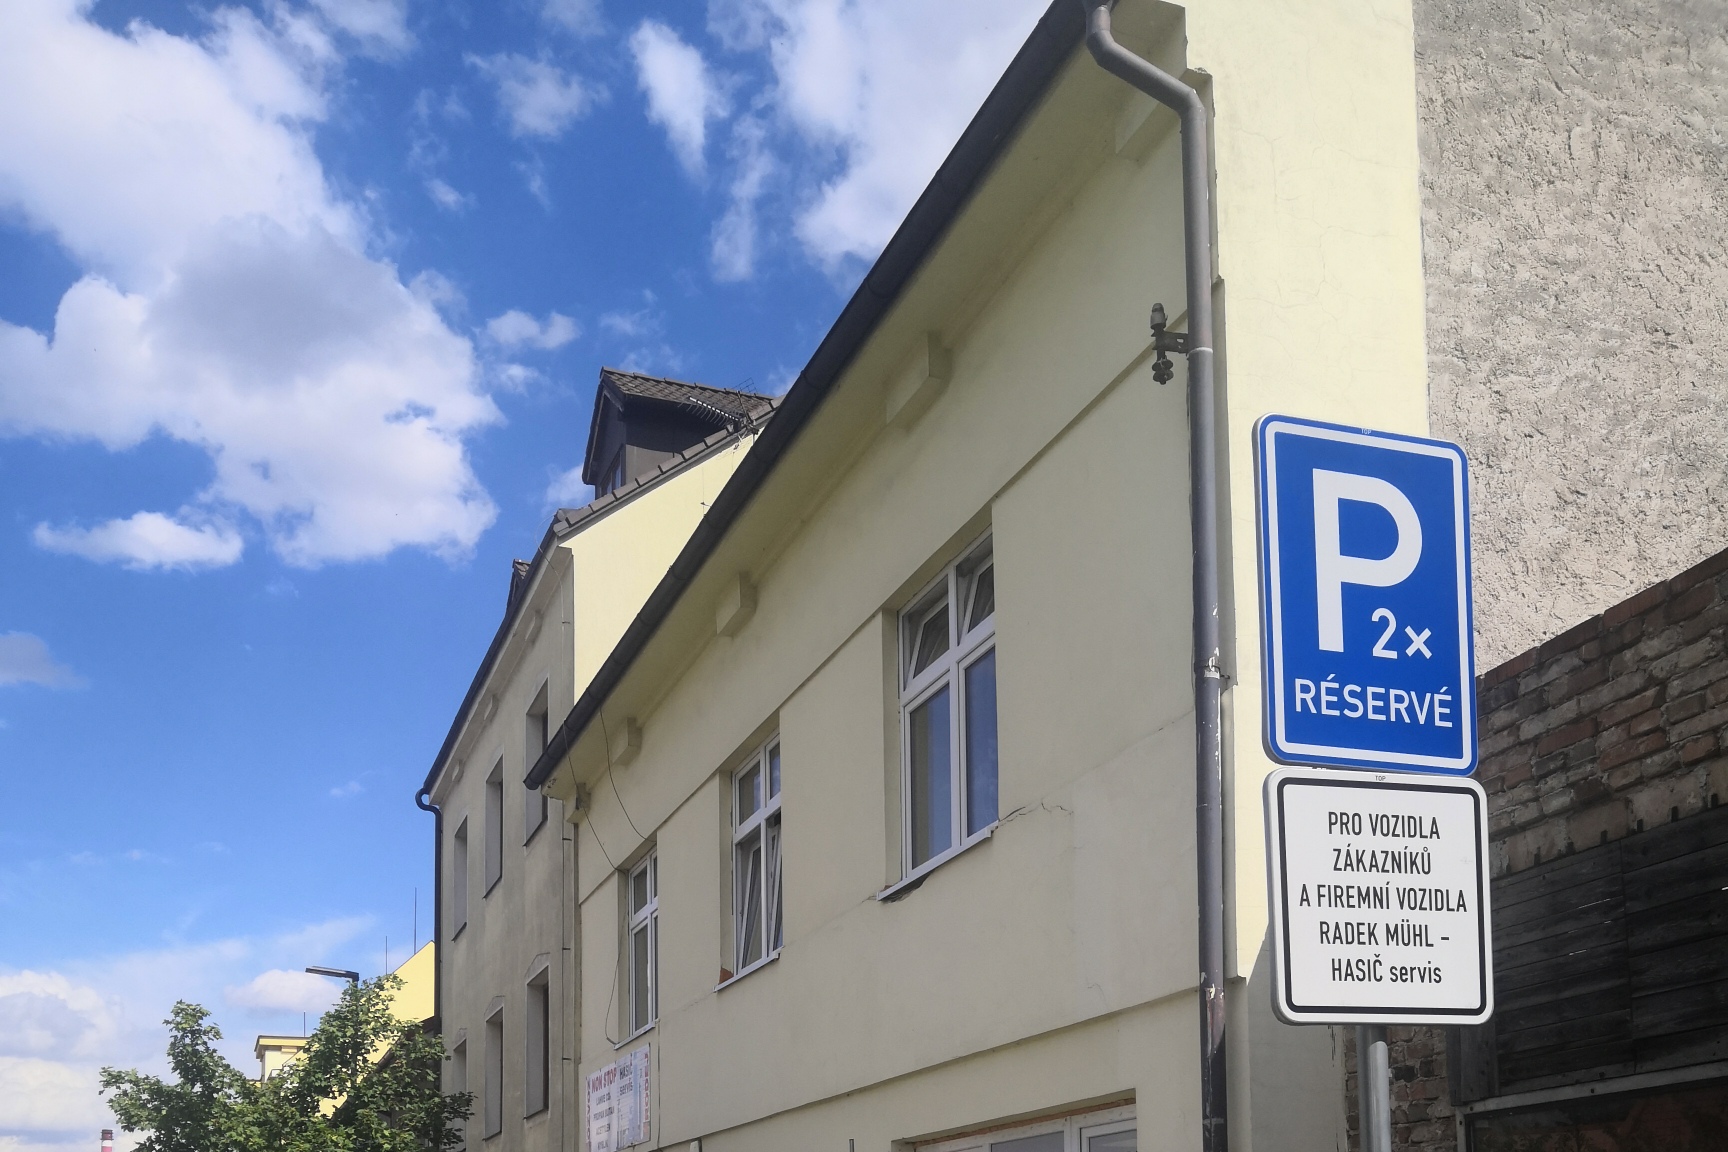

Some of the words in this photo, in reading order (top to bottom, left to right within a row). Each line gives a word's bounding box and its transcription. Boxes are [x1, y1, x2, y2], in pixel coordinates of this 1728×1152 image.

[1312, 468, 1423, 653] P
[1294, 673, 1453, 728] RÉSERVÉ
[1328, 811, 1362, 836] PRO
[1369, 813, 1441, 840] VOZIDLA
[1332, 843, 1432, 875] ZÁKAZNÍKŮ
[1299, 883, 1311, 907] A
[1316, 881, 1390, 910] FIREMNÍ
[1396, 887, 1468, 913] VOZIDLA
[1319, 920, 1379, 946] RADEK
[1385, 919, 1434, 948] MÜHL
[1331, 953, 1383, 982] HASIČ
[1389, 960, 1442, 984] servis
[592, 1075, 602, 1093] NON
[603, 1067, 617, 1088] STOP
